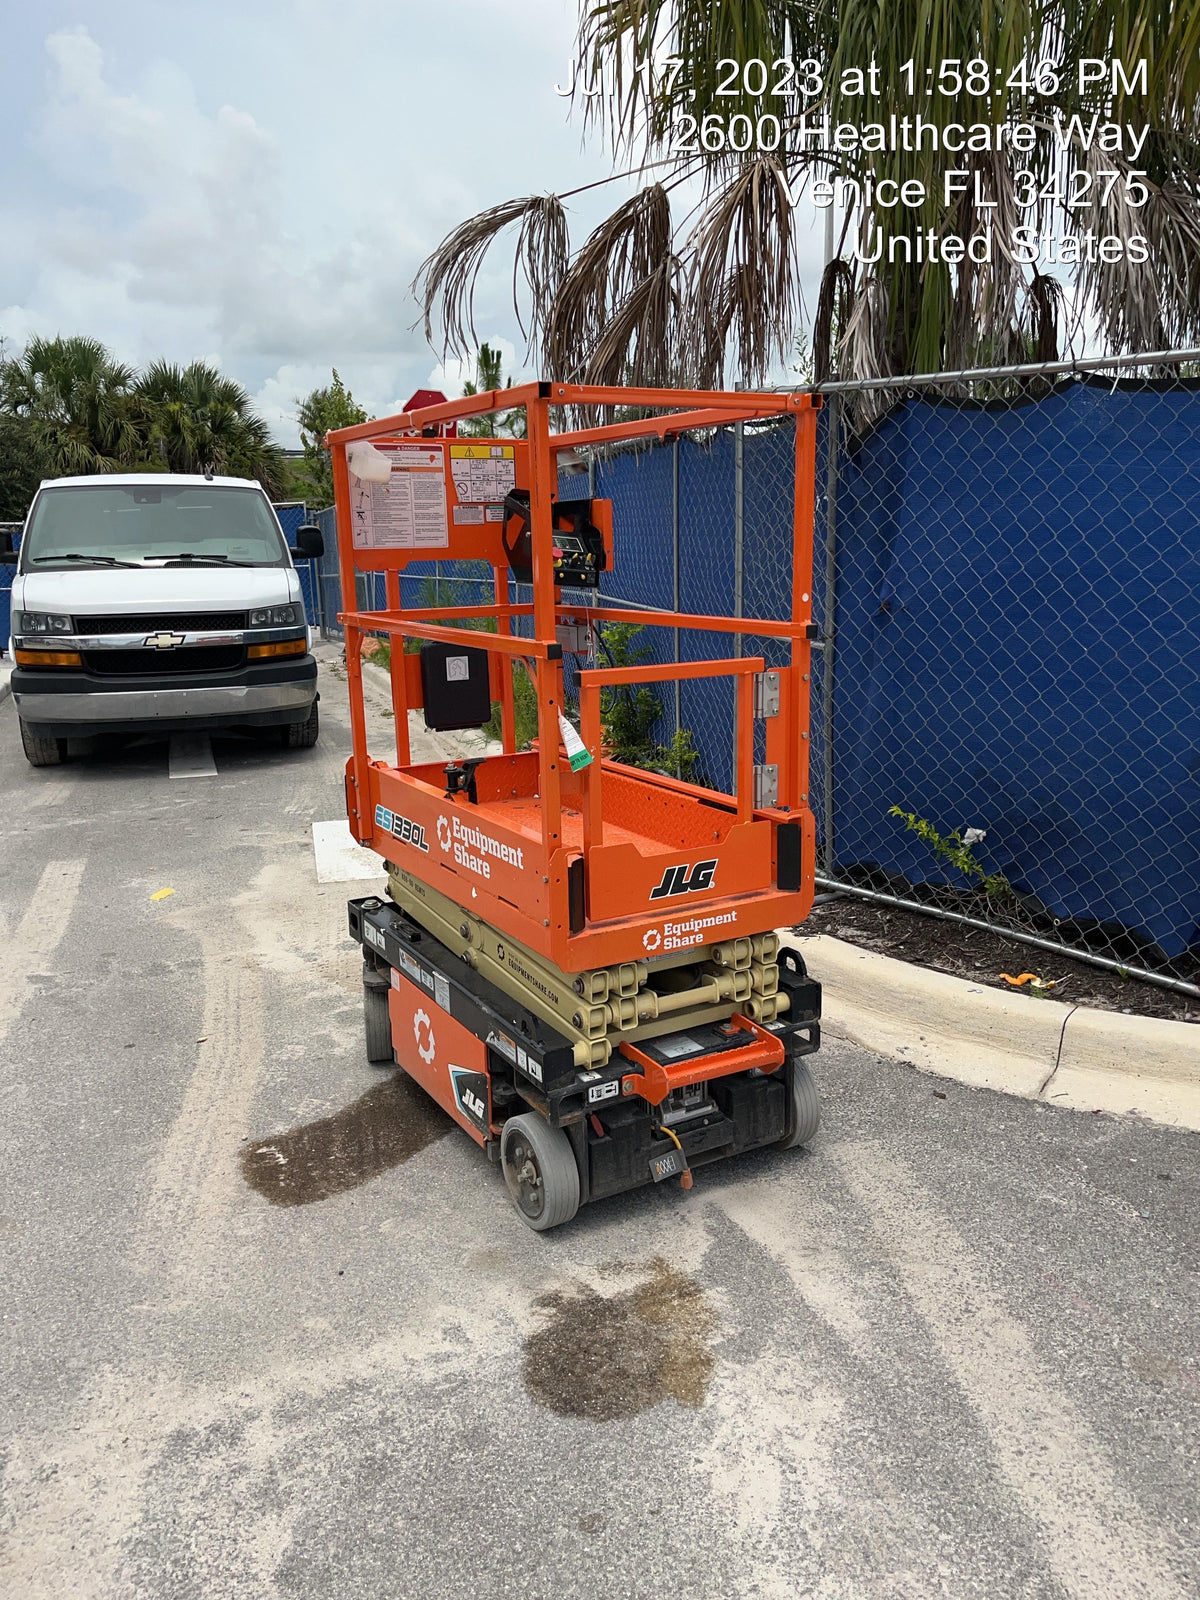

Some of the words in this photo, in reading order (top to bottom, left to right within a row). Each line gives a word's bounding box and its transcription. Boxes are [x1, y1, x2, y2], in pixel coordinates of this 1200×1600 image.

[375, 804, 429, 852] ES1330L
[452, 815, 524, 870] Equipment
[453, 844, 491, 879] Share
[650, 858, 719, 900] JLG
[663, 911, 737, 936] Equipment
[663, 933, 704, 950] Share
[461, 1088, 485, 1119] JLG
